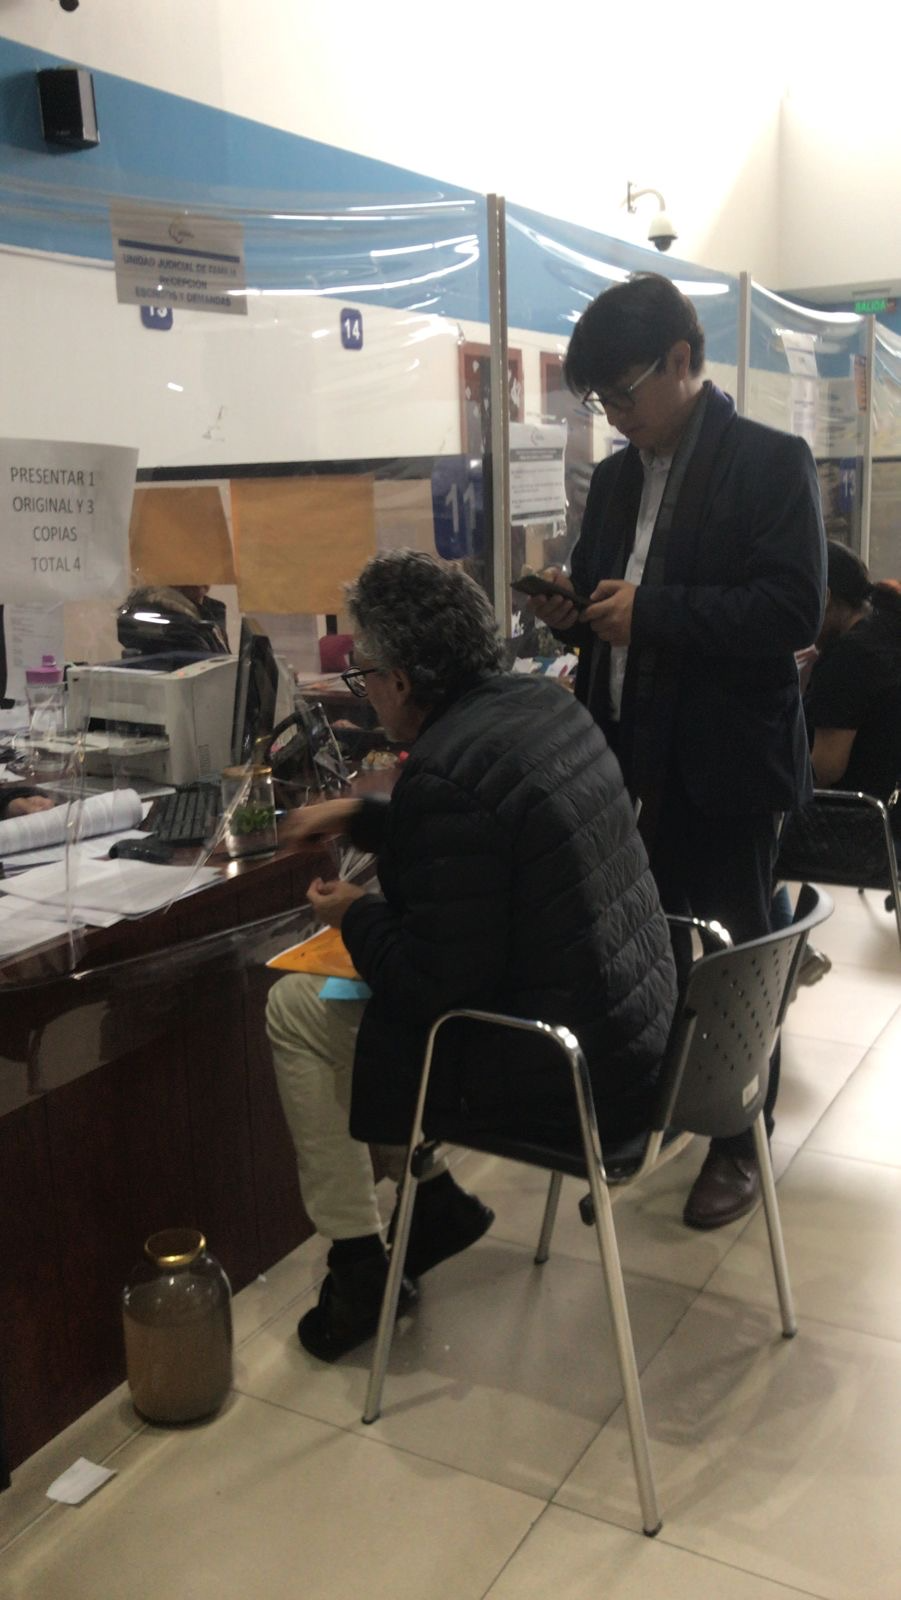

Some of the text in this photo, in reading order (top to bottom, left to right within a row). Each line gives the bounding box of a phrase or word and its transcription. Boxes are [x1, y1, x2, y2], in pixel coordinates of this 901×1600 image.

[122, 254, 155, 267] UNIDAD
[158, 258, 192, 273] JUDICIAL
[195, 263, 206, 273] DE
[186, 292, 232, 307] DEMANDAS
[344, 318, 360, 340] 14
[10, 466, 96, 487] PRESENTAR 1
[12, 496, 95, 514] ORIGINAL Y 3
[445, 482, 476, 534] 11
[33, 525, 78, 542] COPIAS
[31, 556, 82, 572] TOTAL 4
